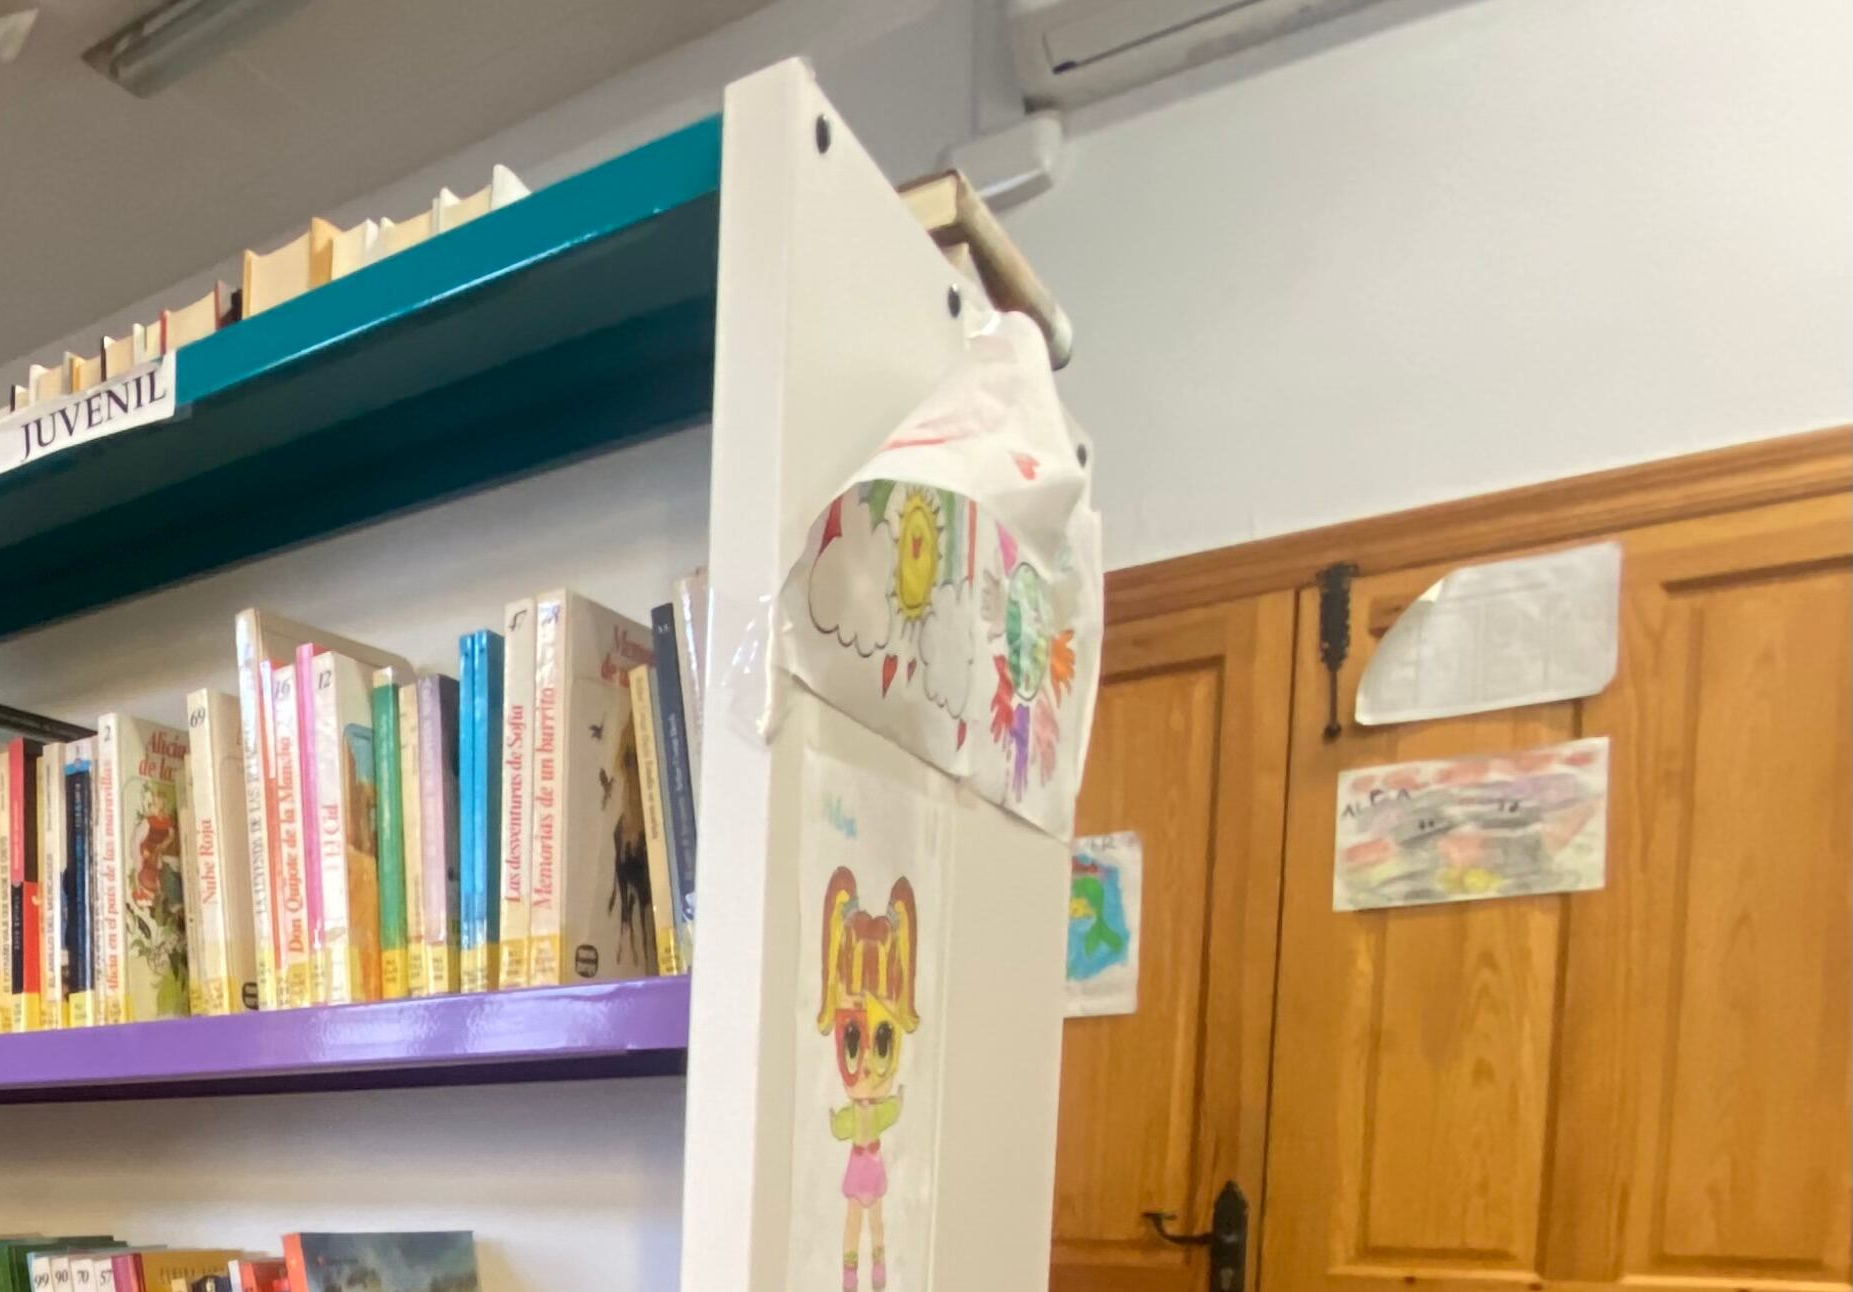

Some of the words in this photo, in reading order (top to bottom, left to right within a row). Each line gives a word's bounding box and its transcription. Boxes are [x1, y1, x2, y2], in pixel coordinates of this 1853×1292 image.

[20, 370, 167, 459] JUVENIL
[317, 669, 333, 691] 12
[189, 708, 206, 728] 69
[534, 686, 554, 752] burrito
[104, 725, 112, 742] 2
[274, 736, 294, 804] Mancha
[505, 752, 522, 770] de
[538, 757, 552, 780] un
[534, 786, 552, 807] de
[278, 808, 294, 824] la
[320, 804, 339, 835] Cid
[504, 773, 523, 868] desventuras
[198, 818, 215, 856] Roja
[280, 829, 296, 849] de
[532, 814, 553, 909] Memorias
[201, 865, 217, 905] Nube
[281, 853, 302, 913] Quijote
[285, 918, 302, 953] Don
[34, 1273, 49, 1288] 99
[55, 1269, 69, 1284] 90
[77, 1269, 89, 1284] 70
